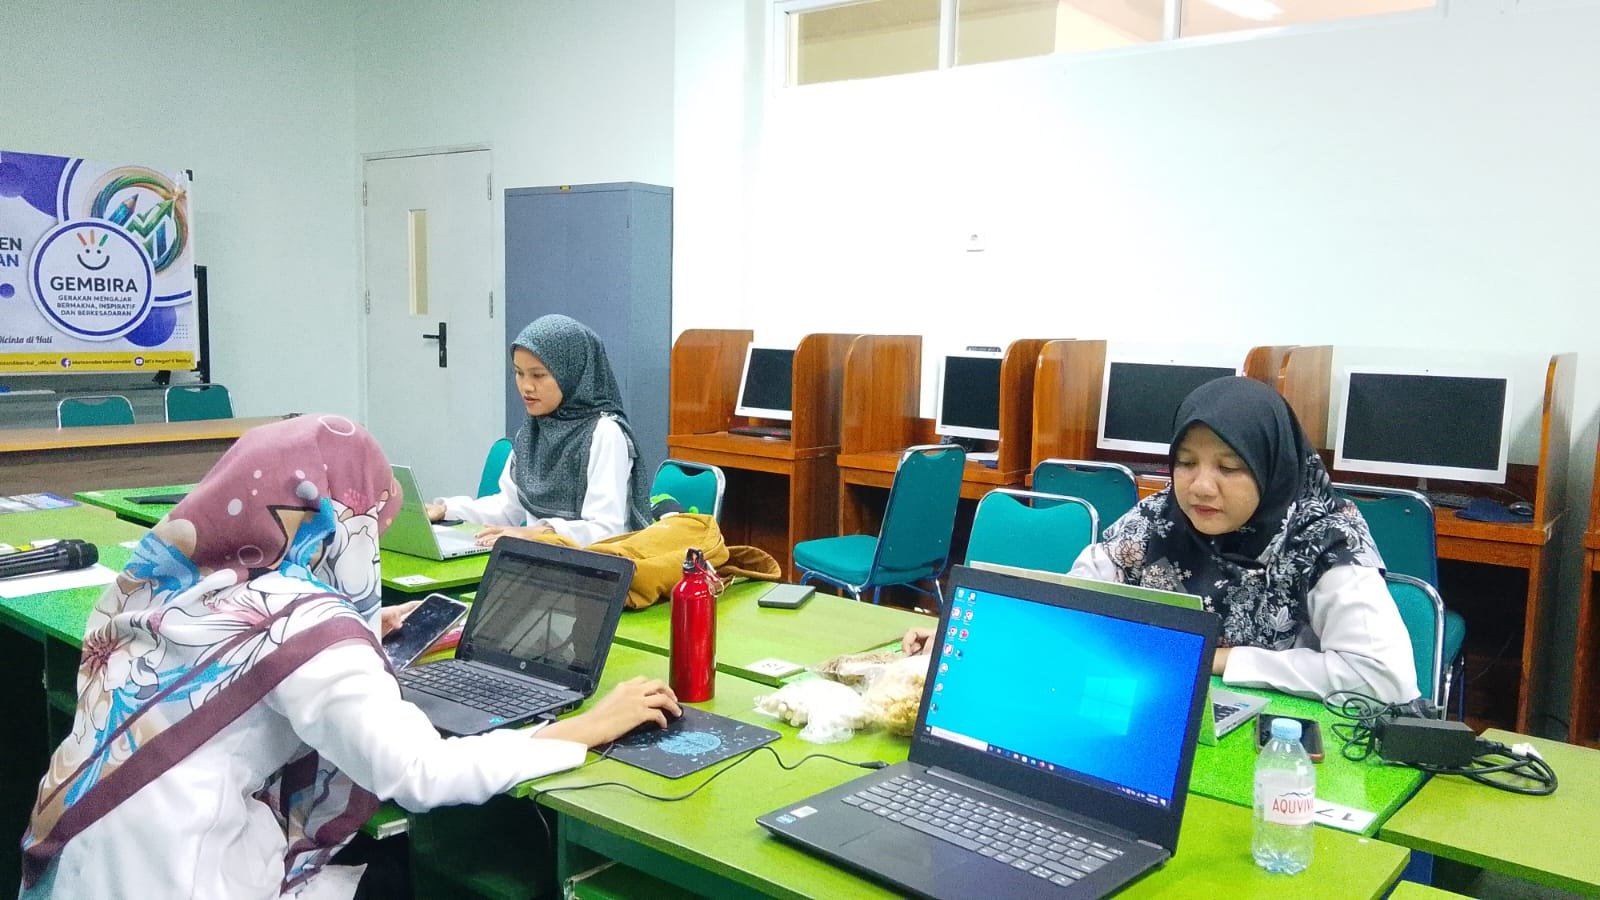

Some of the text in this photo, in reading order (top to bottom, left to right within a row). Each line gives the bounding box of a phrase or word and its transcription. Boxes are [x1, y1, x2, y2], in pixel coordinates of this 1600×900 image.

[0, 237, 22, 251] EN
[50, 276, 138, 293] GEMBIRA
[58, 294, 92, 302] GERAKAN
[57, 302, 98, 310] BERMAKNA,
